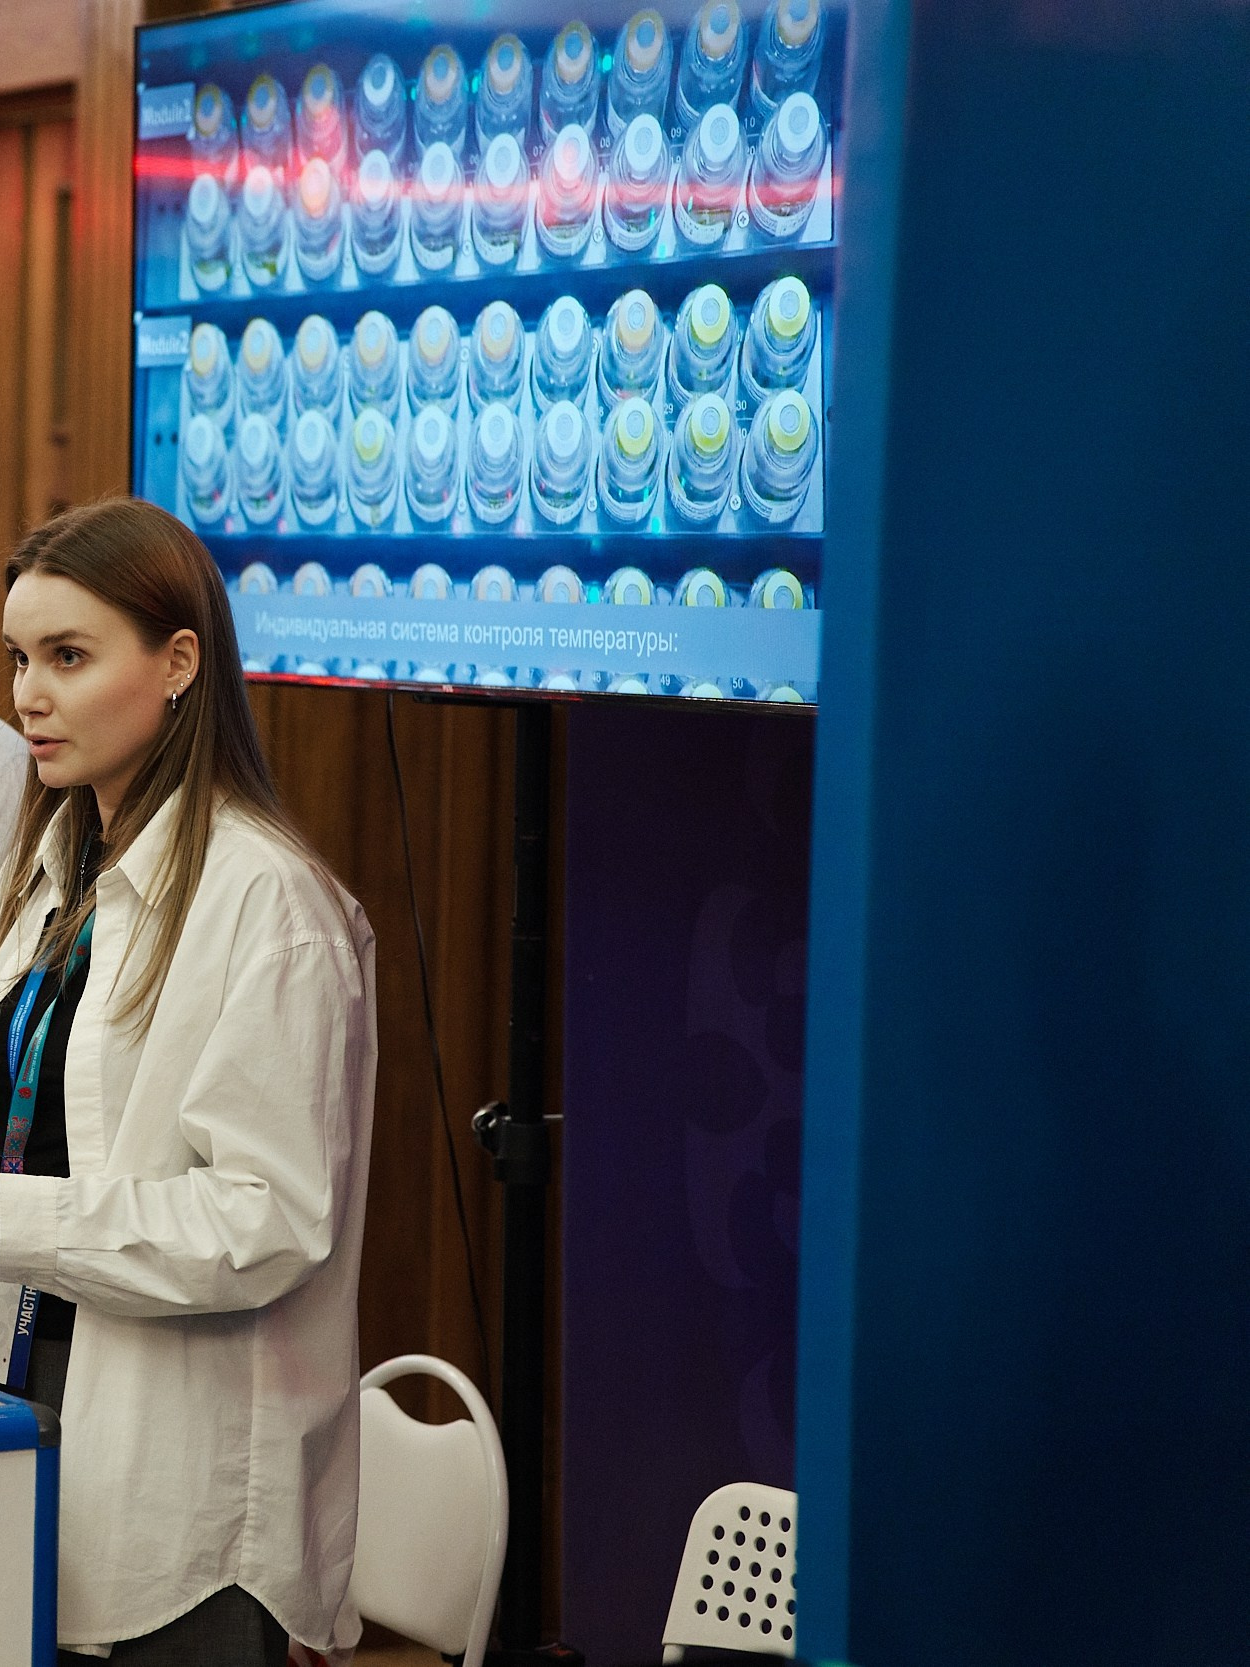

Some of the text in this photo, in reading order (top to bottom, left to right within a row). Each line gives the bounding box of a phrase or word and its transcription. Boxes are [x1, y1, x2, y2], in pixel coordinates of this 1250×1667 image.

[736, 399, 747, 411] 30
[255, 611, 679, 657] Индивидуальная система контроля температуры:
[660, 674, 671, 686] 49
[733, 678, 744, 689] 50
